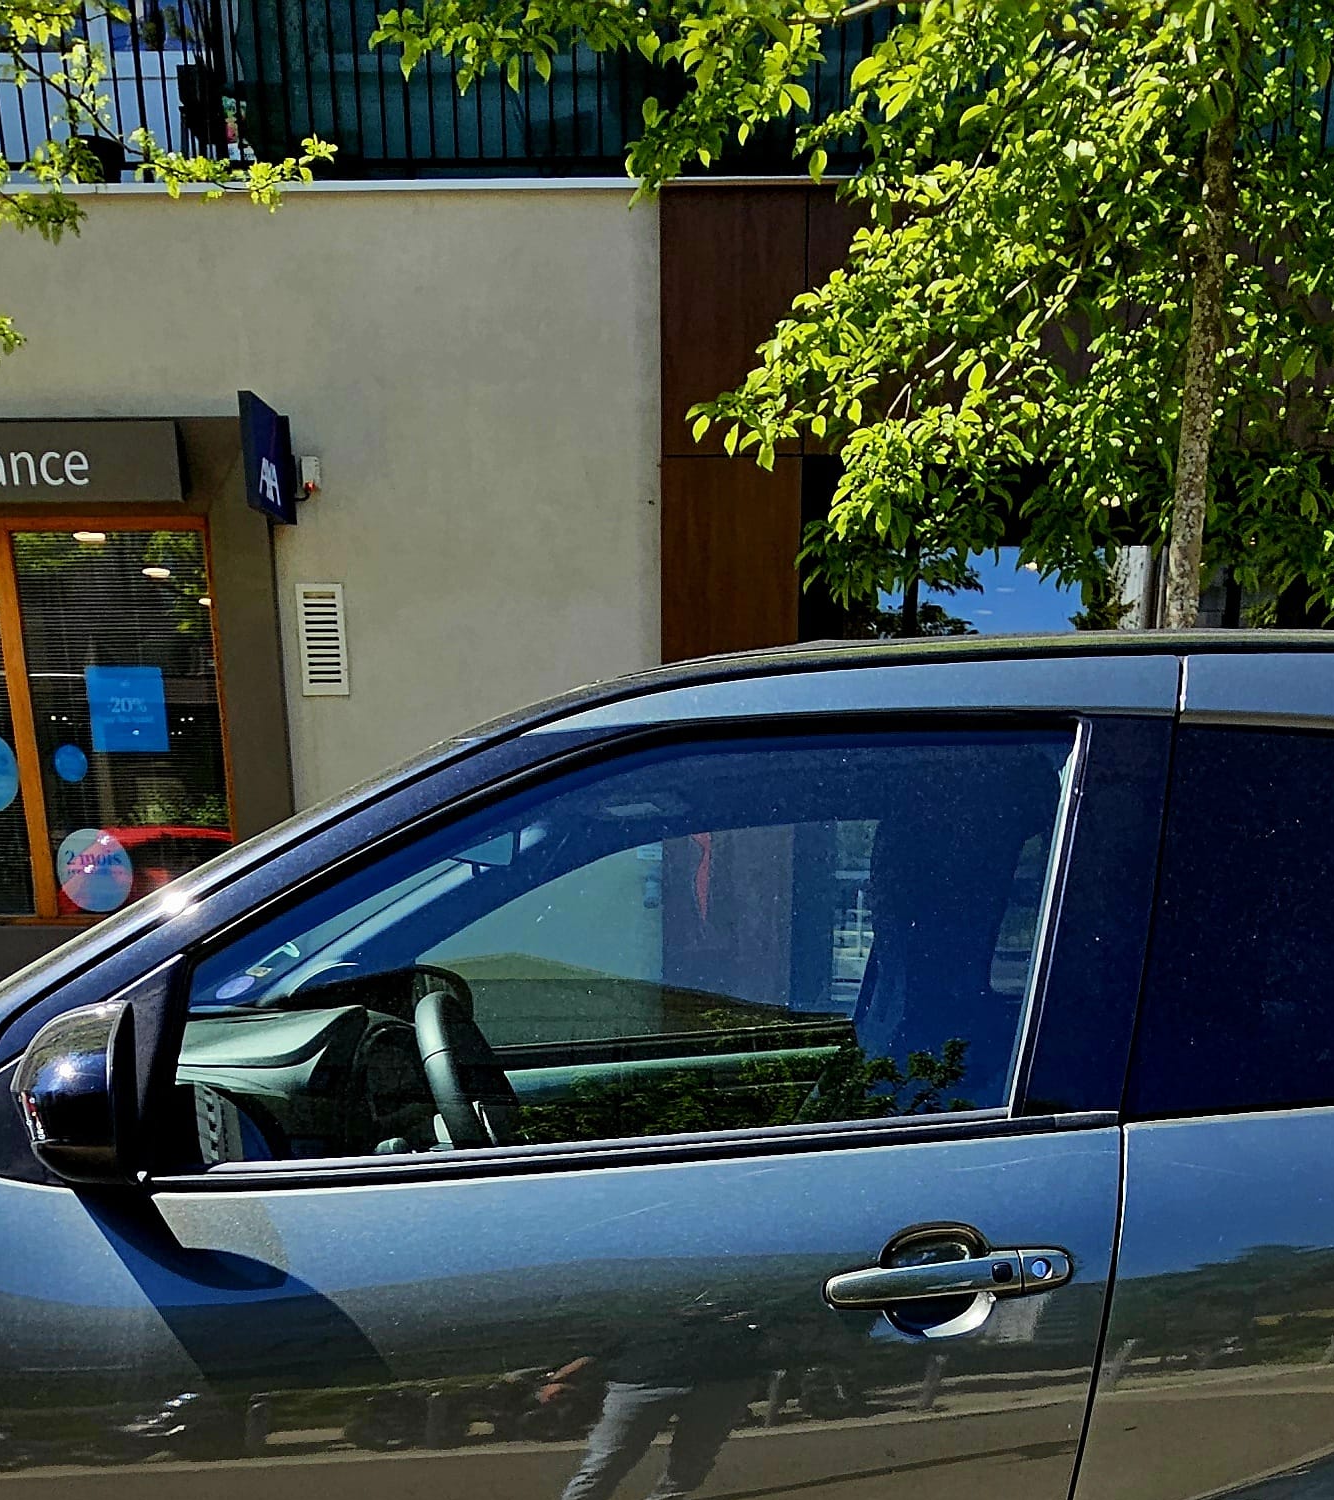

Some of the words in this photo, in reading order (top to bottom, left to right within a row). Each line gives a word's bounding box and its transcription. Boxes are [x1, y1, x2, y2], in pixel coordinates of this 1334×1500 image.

[259, 457, 282, 507] AXA
[65, 849, 76, 865] 2
[79, 849, 122, 866] mois
